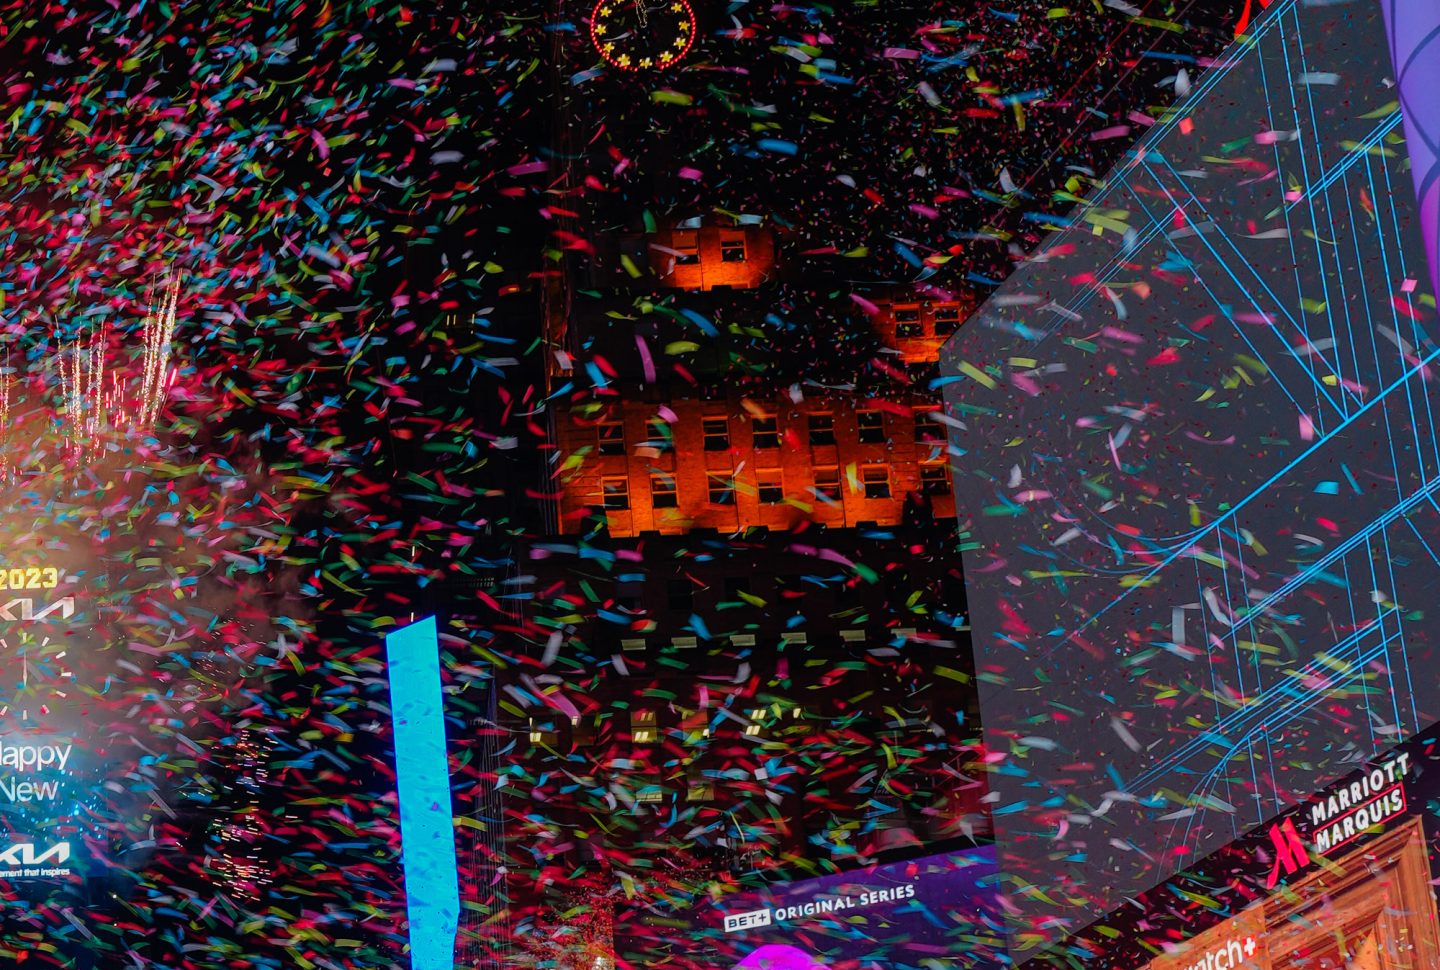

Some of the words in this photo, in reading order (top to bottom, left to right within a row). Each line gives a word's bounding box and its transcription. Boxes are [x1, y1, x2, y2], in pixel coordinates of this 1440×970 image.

[1312, 752, 1410, 826] MARRIOTT
[1316, 789, 1404, 853] MARQUIS
[24, 868, 40, 877] that
[727, 913, 767, 929] BET+
[775, 896, 855, 921] ORIGINAL
[860, 884, 915, 906] SERIES
